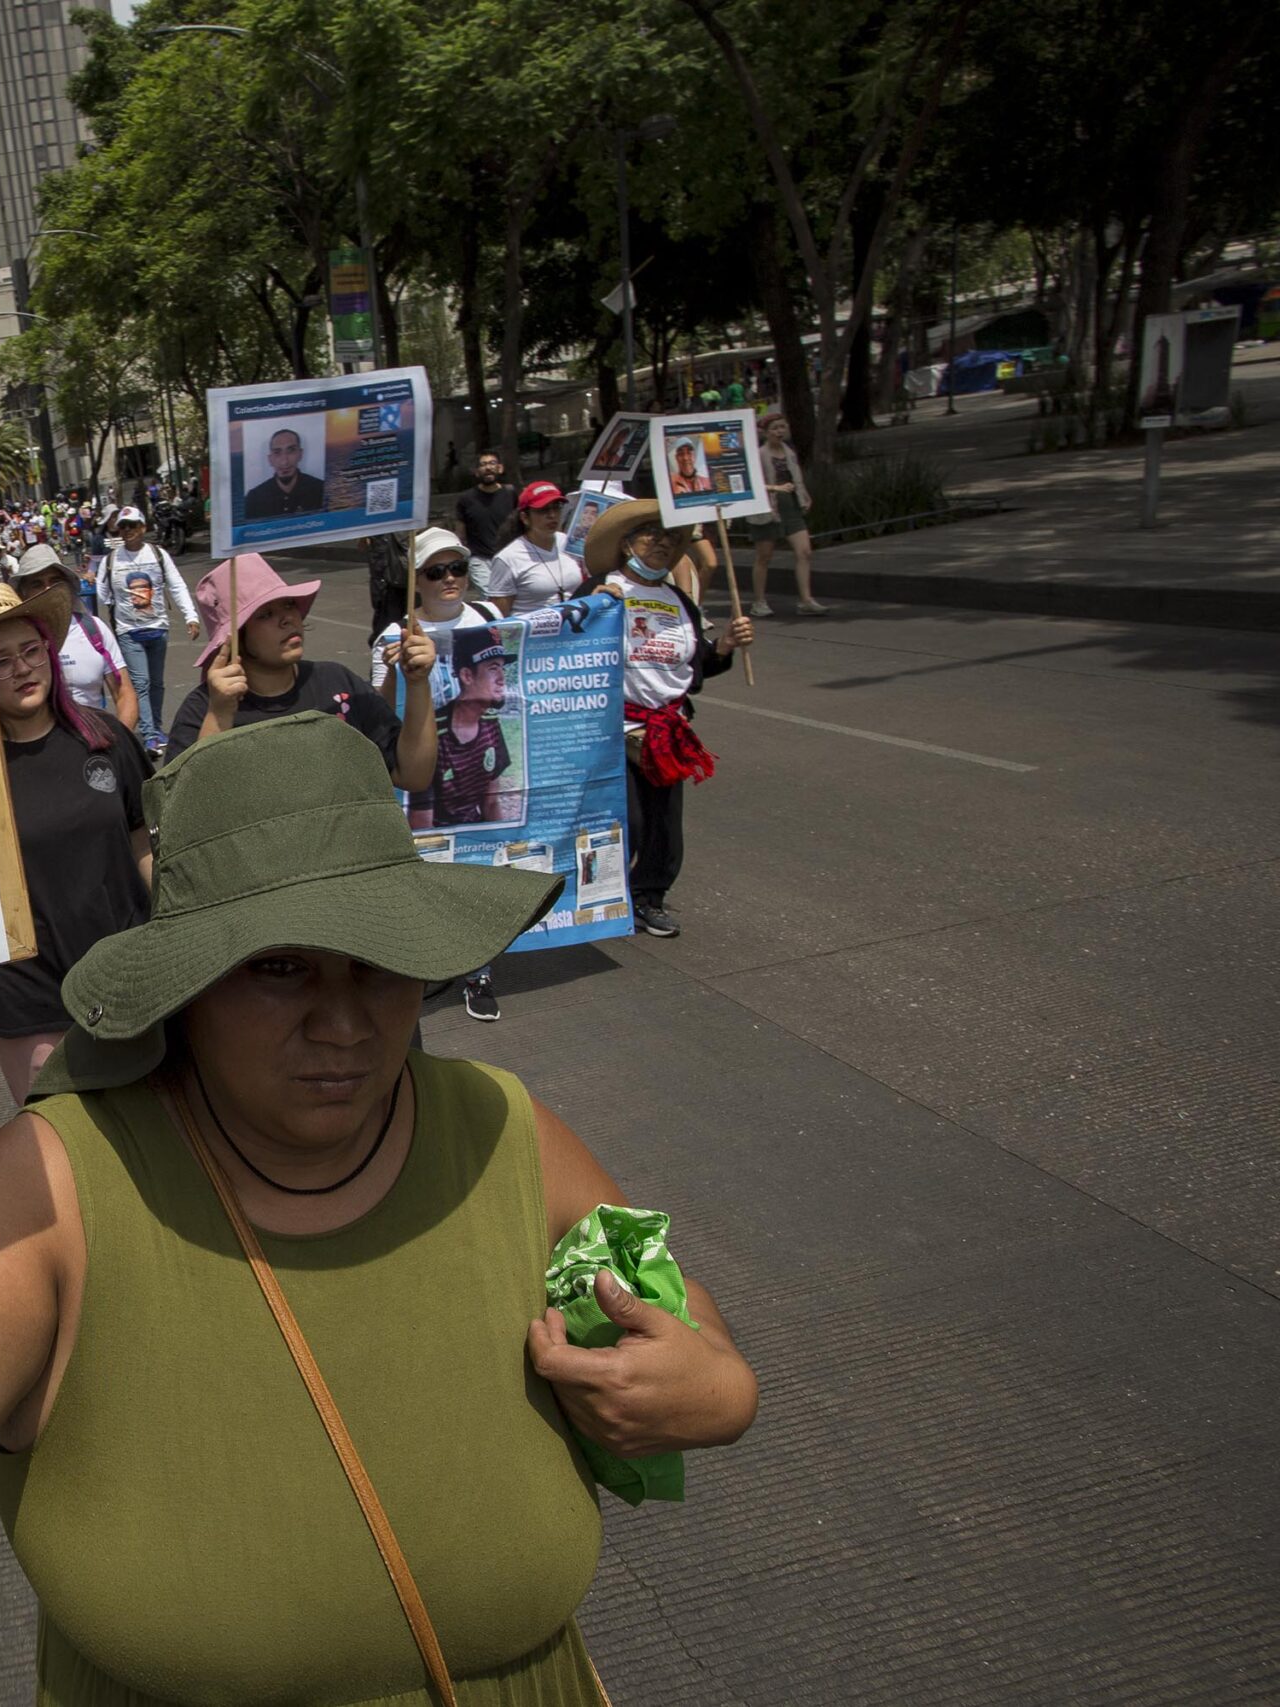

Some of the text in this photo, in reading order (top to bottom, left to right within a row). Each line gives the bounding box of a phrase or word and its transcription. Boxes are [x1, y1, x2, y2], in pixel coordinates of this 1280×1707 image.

[525, 651, 620, 674] LUIS ALBERTO
[527, 673, 611, 695] RODRIGUEZ
[530, 694, 609, 715] ANGUIANO
